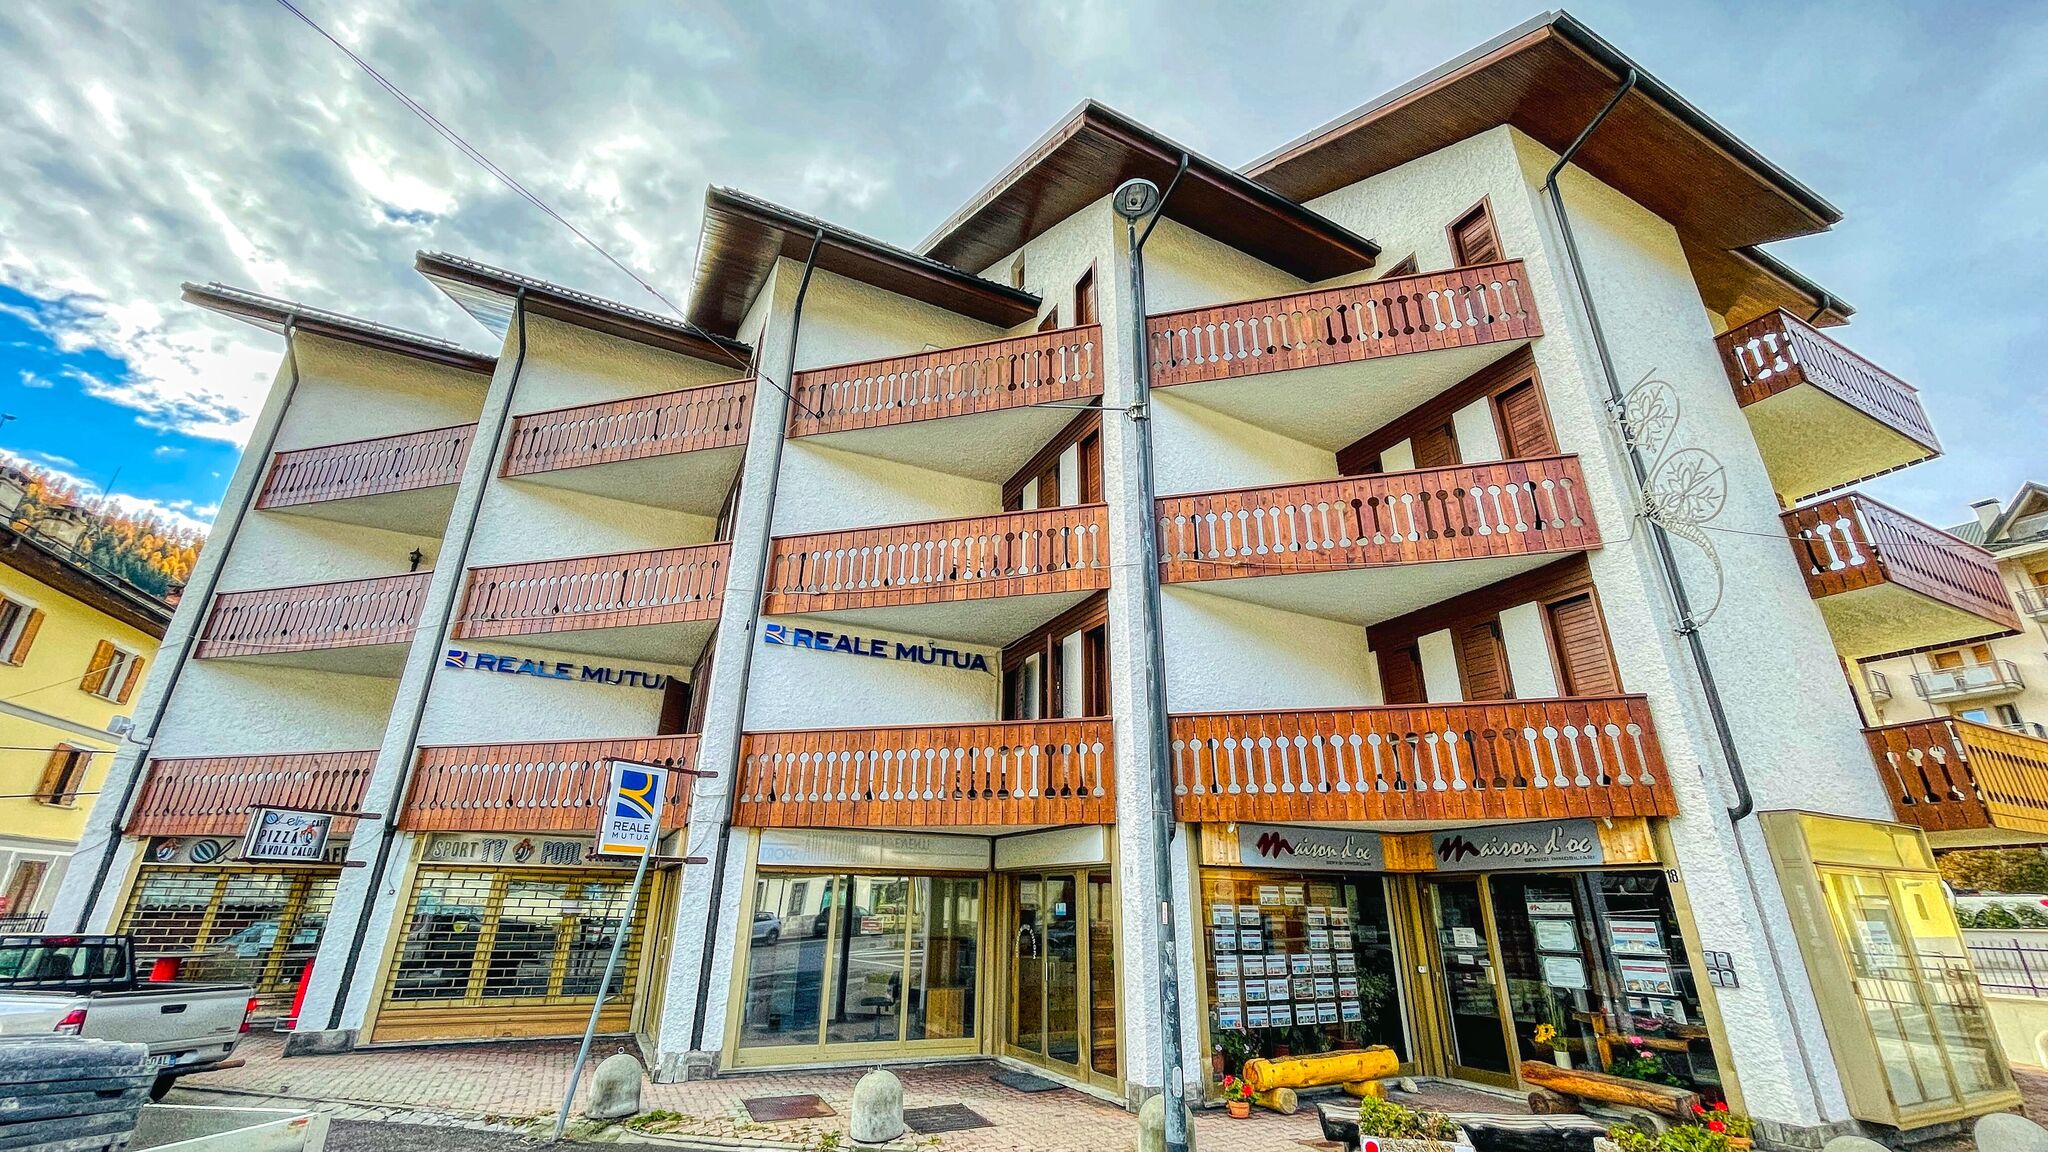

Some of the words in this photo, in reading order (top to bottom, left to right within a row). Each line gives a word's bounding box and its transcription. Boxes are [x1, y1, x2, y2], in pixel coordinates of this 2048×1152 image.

[794, 628, 888, 658] REALE
[895, 641, 989, 673] MUTUA
[474, 653, 573, 680] REALE
[611, 832, 649, 841] MUTUA
[612, 820, 651, 834] REALE
[256, 844, 289, 856] TAVOLA
[291, 846, 319, 857] CALDA
[432, 839, 480, 858] SPORT
[481, 837, 508, 863] TV
[540, 840, 582, 865] POOL
[1256, 831, 1338, 859] Maison
[1437, 834, 1538, 863] Maison
[1666, 869, 1679, 883] 18
